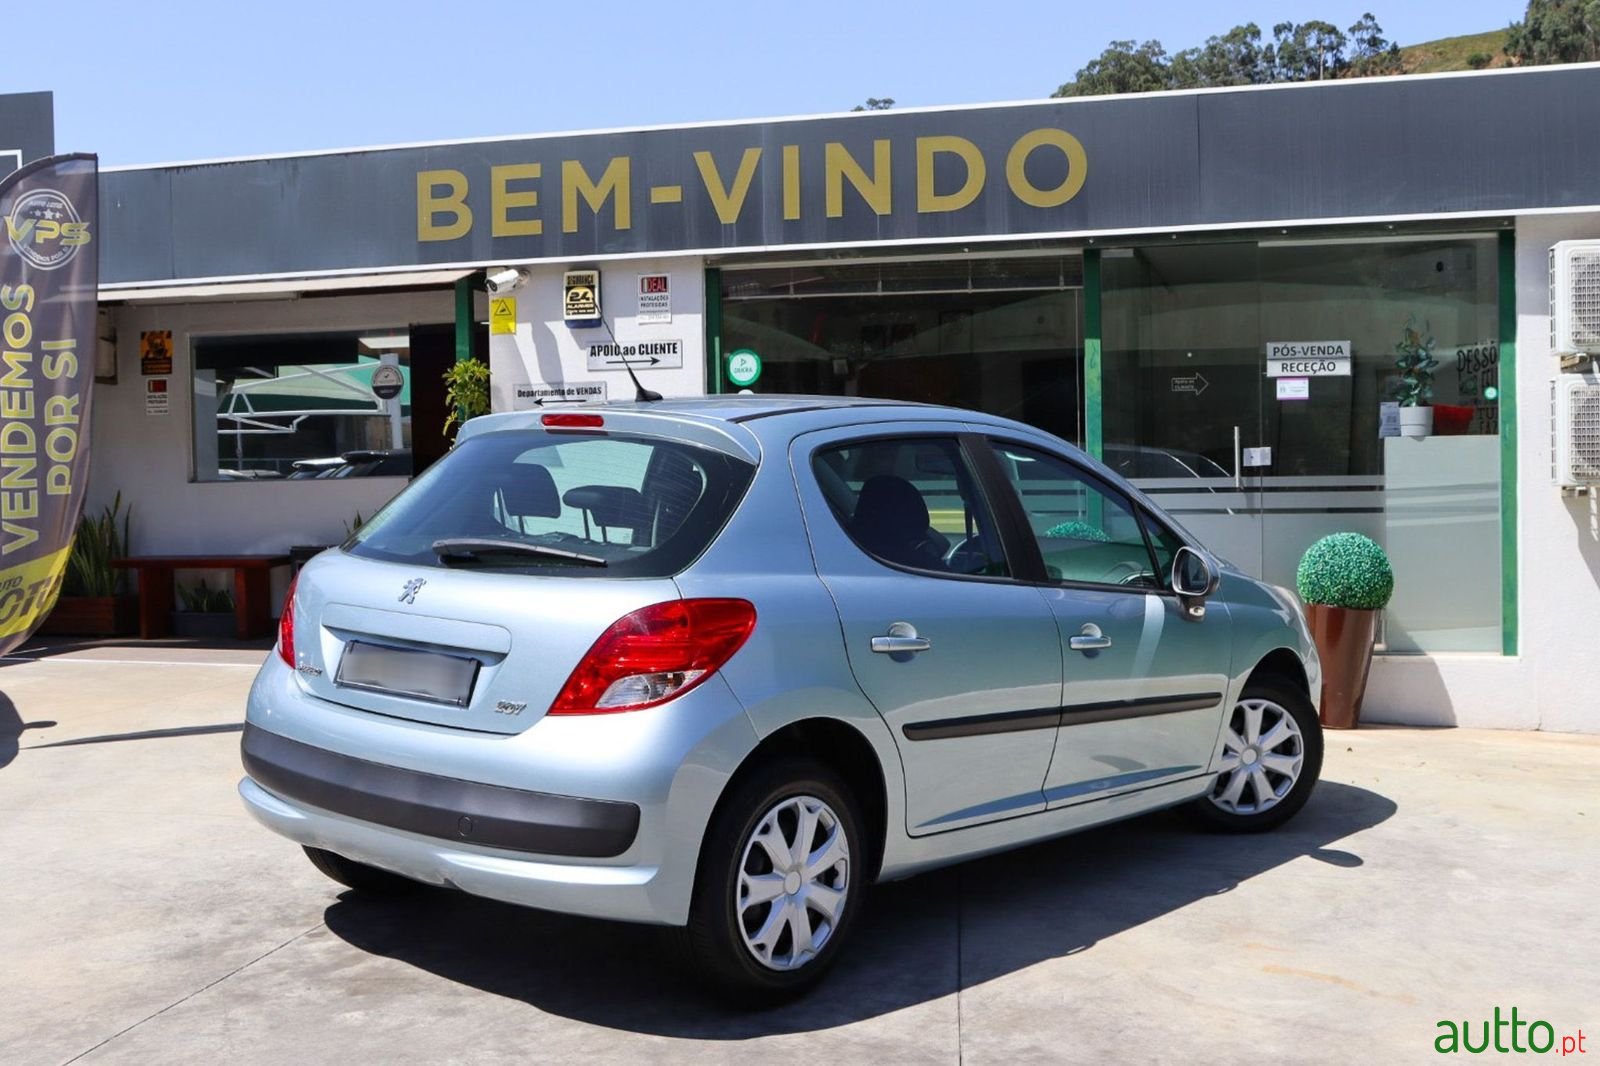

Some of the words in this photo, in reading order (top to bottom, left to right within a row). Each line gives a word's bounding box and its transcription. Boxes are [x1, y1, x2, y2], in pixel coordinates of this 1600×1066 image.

[416, 128, 1088, 242] BEM-VINDO
[4, 216, 91, 245] VPS
[569, 291, 590, 302] 24
[41, 339, 78, 380] SI
[590, 344, 621, 357] APOIO
[622, 346, 636, 356] ao
[638, 343, 678, 355] CLIENTE
[1273, 344, 1344, 357] PÓS-VENDA
[1281, 360, 1336, 374] RECEÇÃO
[517, 388, 565, 398] Departamento
[567, 387, 575, 396] de
[576, 386, 602, 396] VENDAS
[0, 284, 39, 555] VENDEMOS
[45, 393, 79, 495] POR
